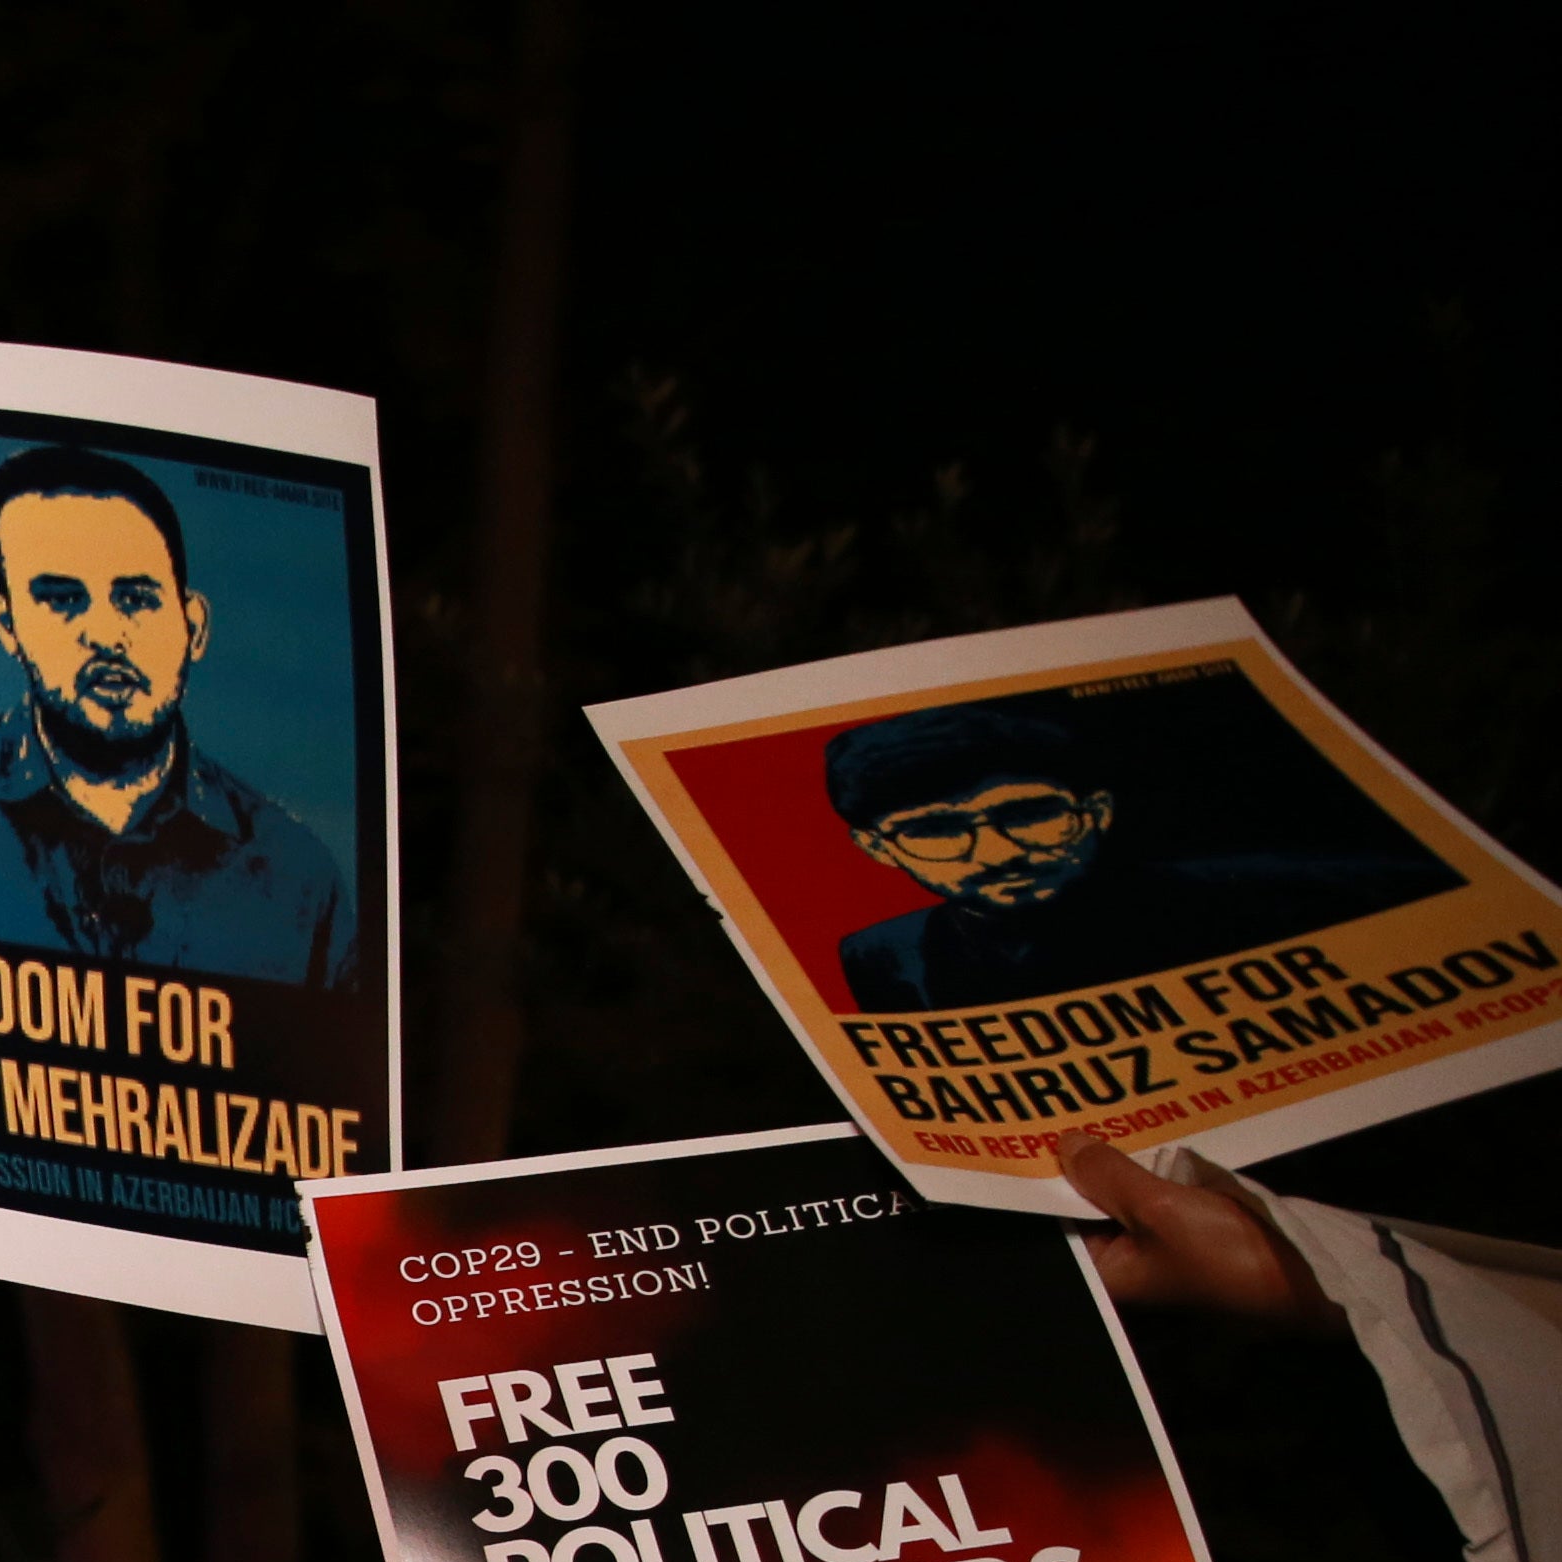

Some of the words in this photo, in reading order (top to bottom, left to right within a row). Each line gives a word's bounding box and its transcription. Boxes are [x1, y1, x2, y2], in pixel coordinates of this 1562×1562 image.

[125, 976, 234, 1069] FOR
[840, 985, 1184, 1070] FREEDOM
[1182, 945, 1350, 1017] FOR
[873, 1045, 1178, 1126] BAHRUZ
[1179, 930, 1560, 1074] SAMADOV
[0, 1057, 360, 1180] MEHRALIZADE
[914, 1131, 980, 1156] END
[980, 1100, 1189, 1159] REPRSSION
[1188, 1087, 1232, 1113] IN
[1238, 1018, 1453, 1101] AZERBAIJAN
[77, 1167, 103, 1202] IN
[110, 1173, 261, 1230] AZERBAIJAN
[399, 1239, 543, 1286] COP29
[587, 1221, 683, 1263] END
[695, 1190, 945, 1246] POLITICA
[411, 1260, 712, 1327] OPPRESSION!
[437, 1353, 675, 1451] FREE
[463, 1436, 669, 1532] 300
